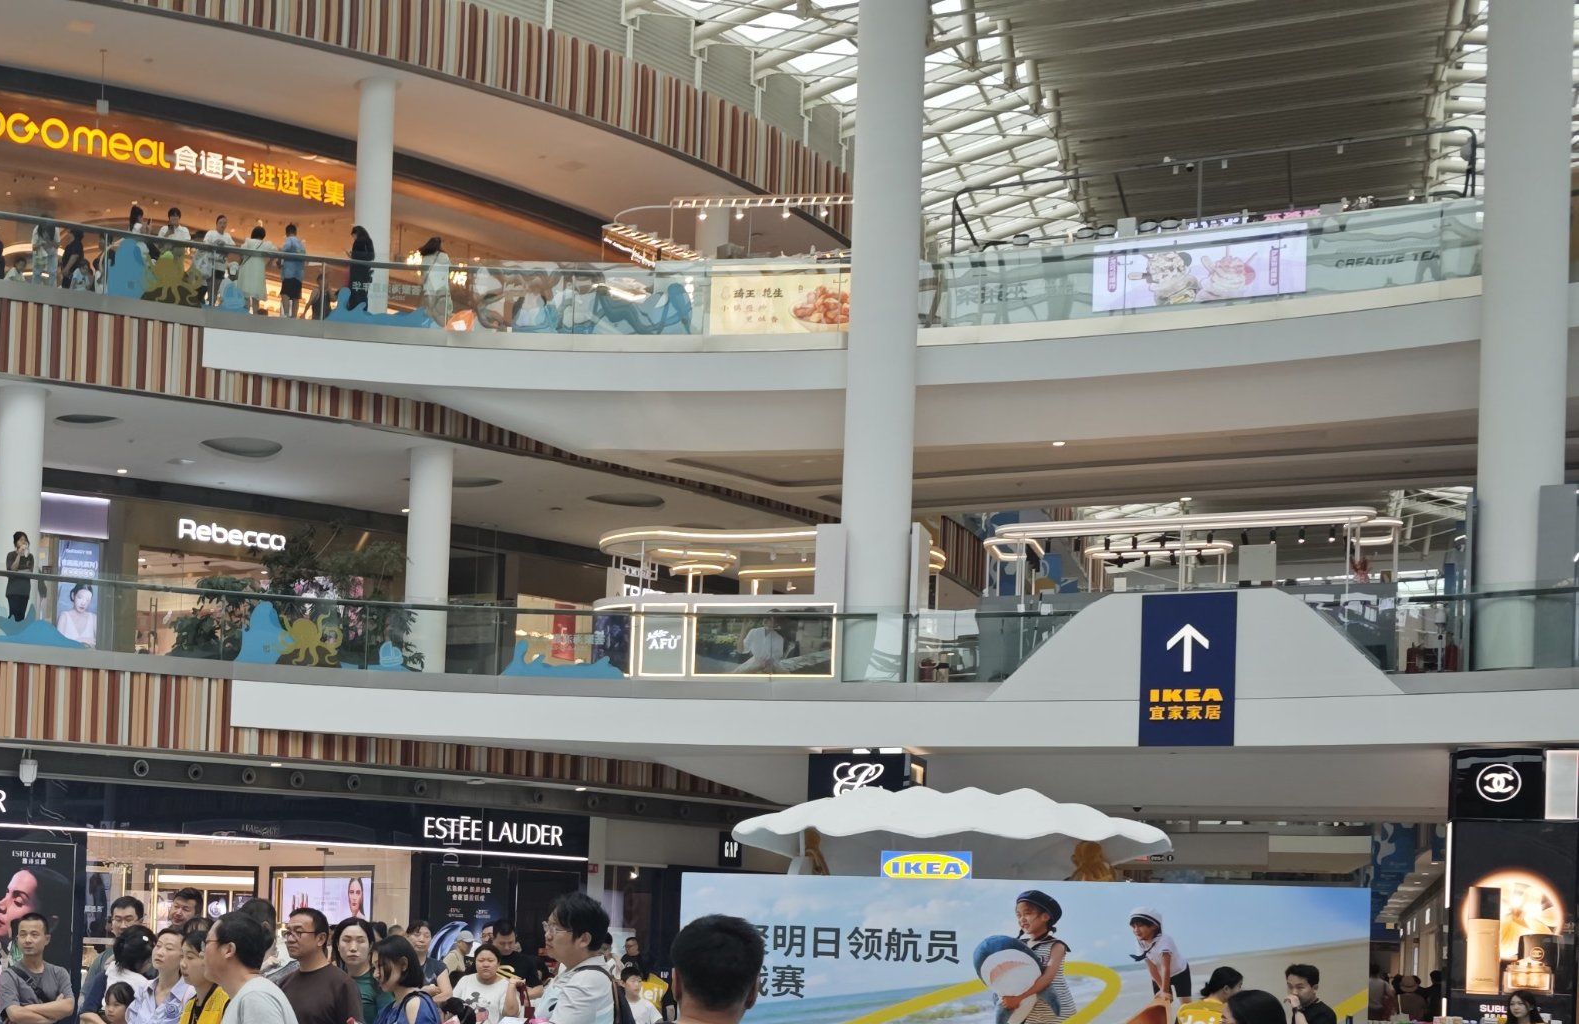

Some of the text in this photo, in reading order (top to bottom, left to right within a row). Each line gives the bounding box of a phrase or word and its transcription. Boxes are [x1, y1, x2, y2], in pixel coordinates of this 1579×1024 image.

[178, 518, 287, 551] Rebecca
[1149, 688, 1223, 702] IKEA
[1149, 705, 1221, 720] 宜家家居
[488, 820, 563, 847] LAUDER
[891, 862, 963, 875] IKEA
[1479, 1004, 1508, 1013] SUBL
